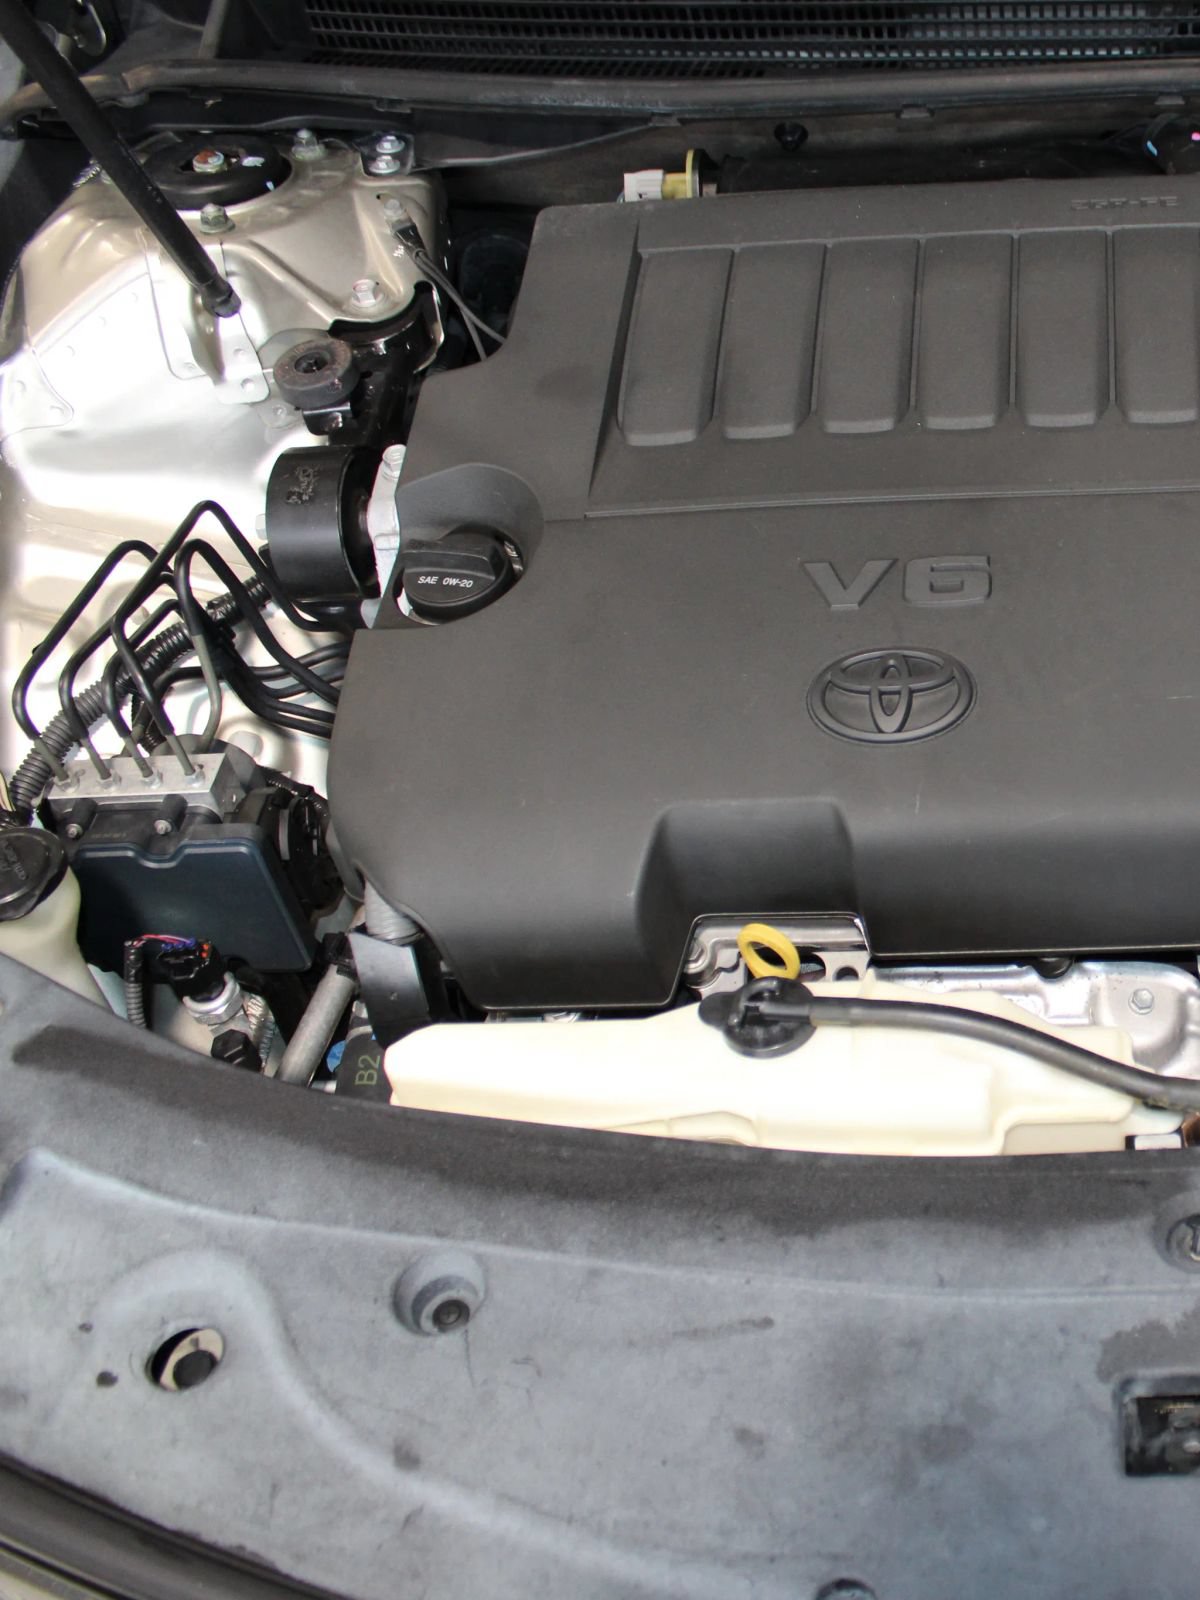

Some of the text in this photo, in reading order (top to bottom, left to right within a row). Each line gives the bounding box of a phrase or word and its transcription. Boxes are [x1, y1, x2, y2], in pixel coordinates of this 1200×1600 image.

[417, 575, 474, 588] SAE 0W-20
[801, 554, 993, 610] V6
[355, 1055, 380, 1085] B2
